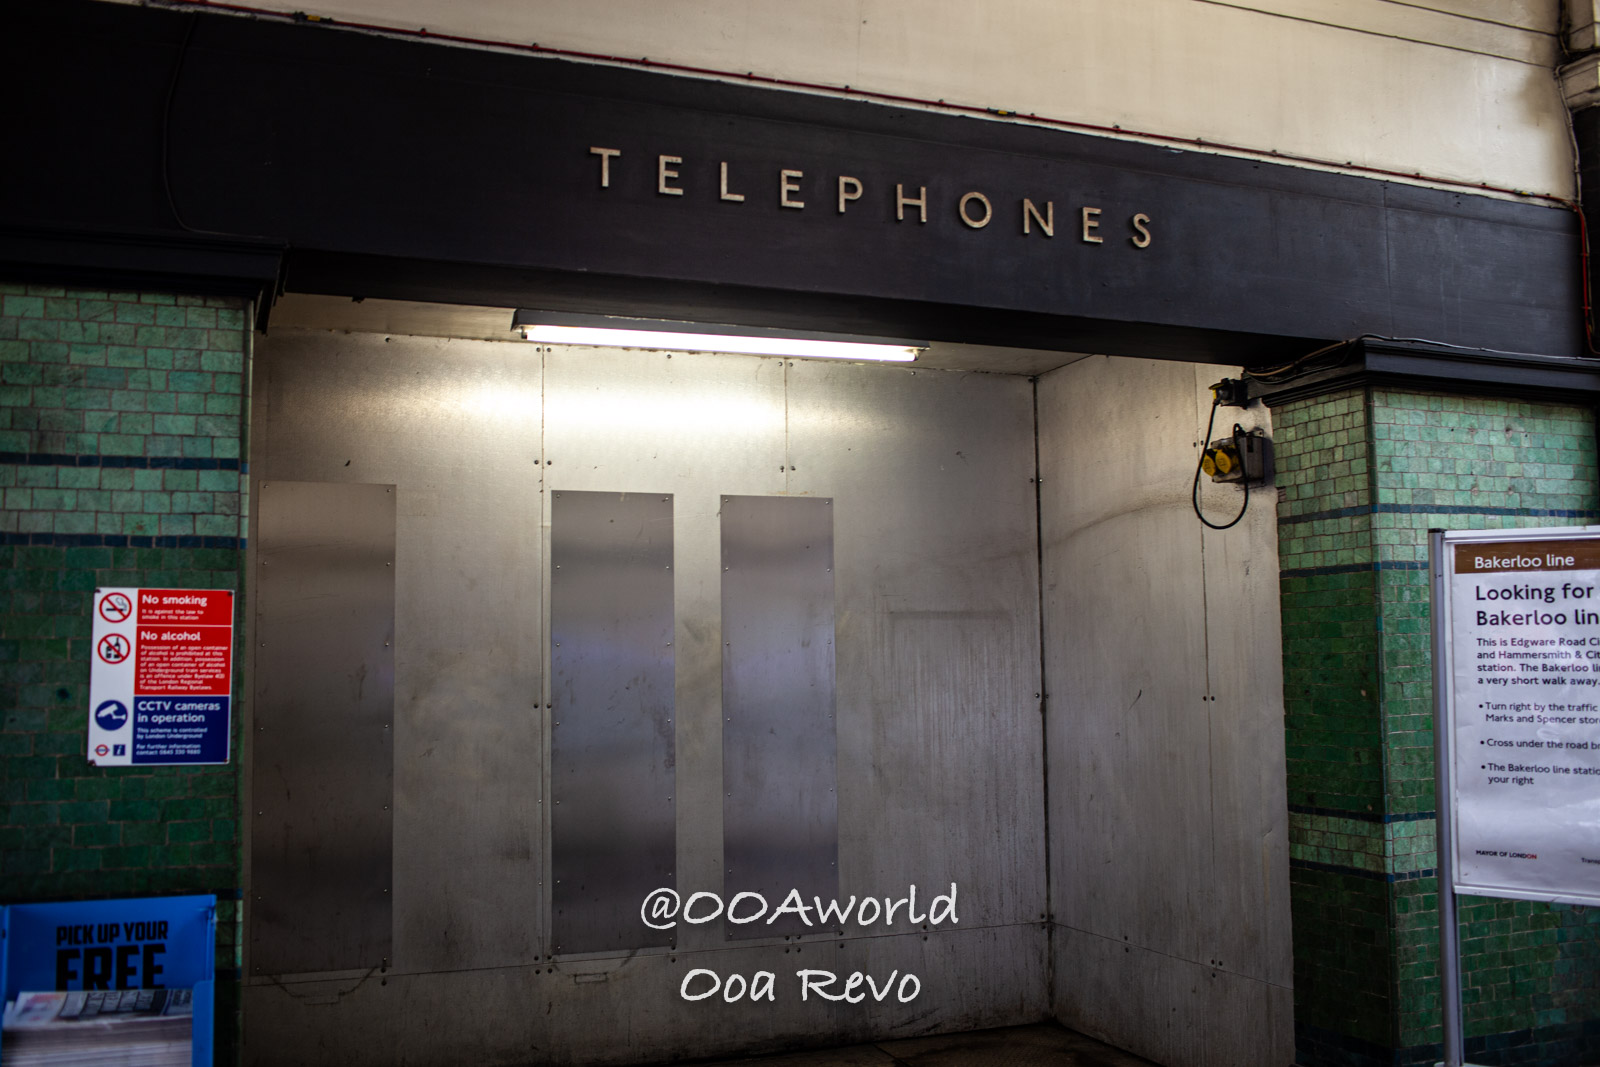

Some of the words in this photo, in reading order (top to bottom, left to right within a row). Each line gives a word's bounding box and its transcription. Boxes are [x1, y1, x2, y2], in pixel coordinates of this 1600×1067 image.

[590, 146, 1152, 248] TELEPHONES
[1475, 555, 1542, 568] Bakerloo
[1546, 554, 1575, 566] line
[1476, 585, 1555, 603] Looking
[1561, 583, 1594, 599] for
[142, 595, 159, 604] No
[163, 596, 208, 607] smoking
[1477, 610, 1567, 625] Bakerloo
[141, 631, 158, 640] No
[161, 631, 201, 641] alcohol
[1477, 638, 1497, 646] This
[1500, 638, 1507, 646] is
[1511, 638, 1556, 648] Edgware
[1559, 638, 1586, 646] Road
[1477, 651, 1495, 659] and
[1498, 650, 1571, 659] Hammersmith
[1478, 663, 1516, 672] station.
[1520, 663, 1538, 671] The
[1542, 663, 1589, 672] Bakerloo
[1487, 678, 1508, 686] very
[1511, 676, 1538, 684] short
[1542, 676, 1566, 685] walk
[1570, 678, 1600, 687] away.
[138, 701, 171, 711] CCTV
[174, 703, 221, 711] cameras
[1486, 702, 1506, 710] Turn
[1509, 703, 1530, 712] right
[1534, 703, 1545, 712] by
[1567, 703, 1598, 712] traffic
[137, 713, 148, 722] in
[151, 713, 205, 725] operation
[1486, 714, 1514, 722] Marks
[1517, 715, 1534, 723] and
[1537, 715, 1576, 724] Spencer
[1579, 716, 1600, 724] stor
[1487, 739, 1513, 747] Cross
[1516, 739, 1543, 748] under
[1488, 763, 1505, 771] The
[1508, 764, 1550, 773] Bakerloo
[1553, 765, 1571, 774] line
[1488, 777, 1509, 785] your
[1512, 776, 1534, 786] right
[56, 924, 94, 945] PICK
[97, 923, 120, 943] UP
[123, 921, 168, 942] YOUR
[56, 943, 166, 991] FREE
